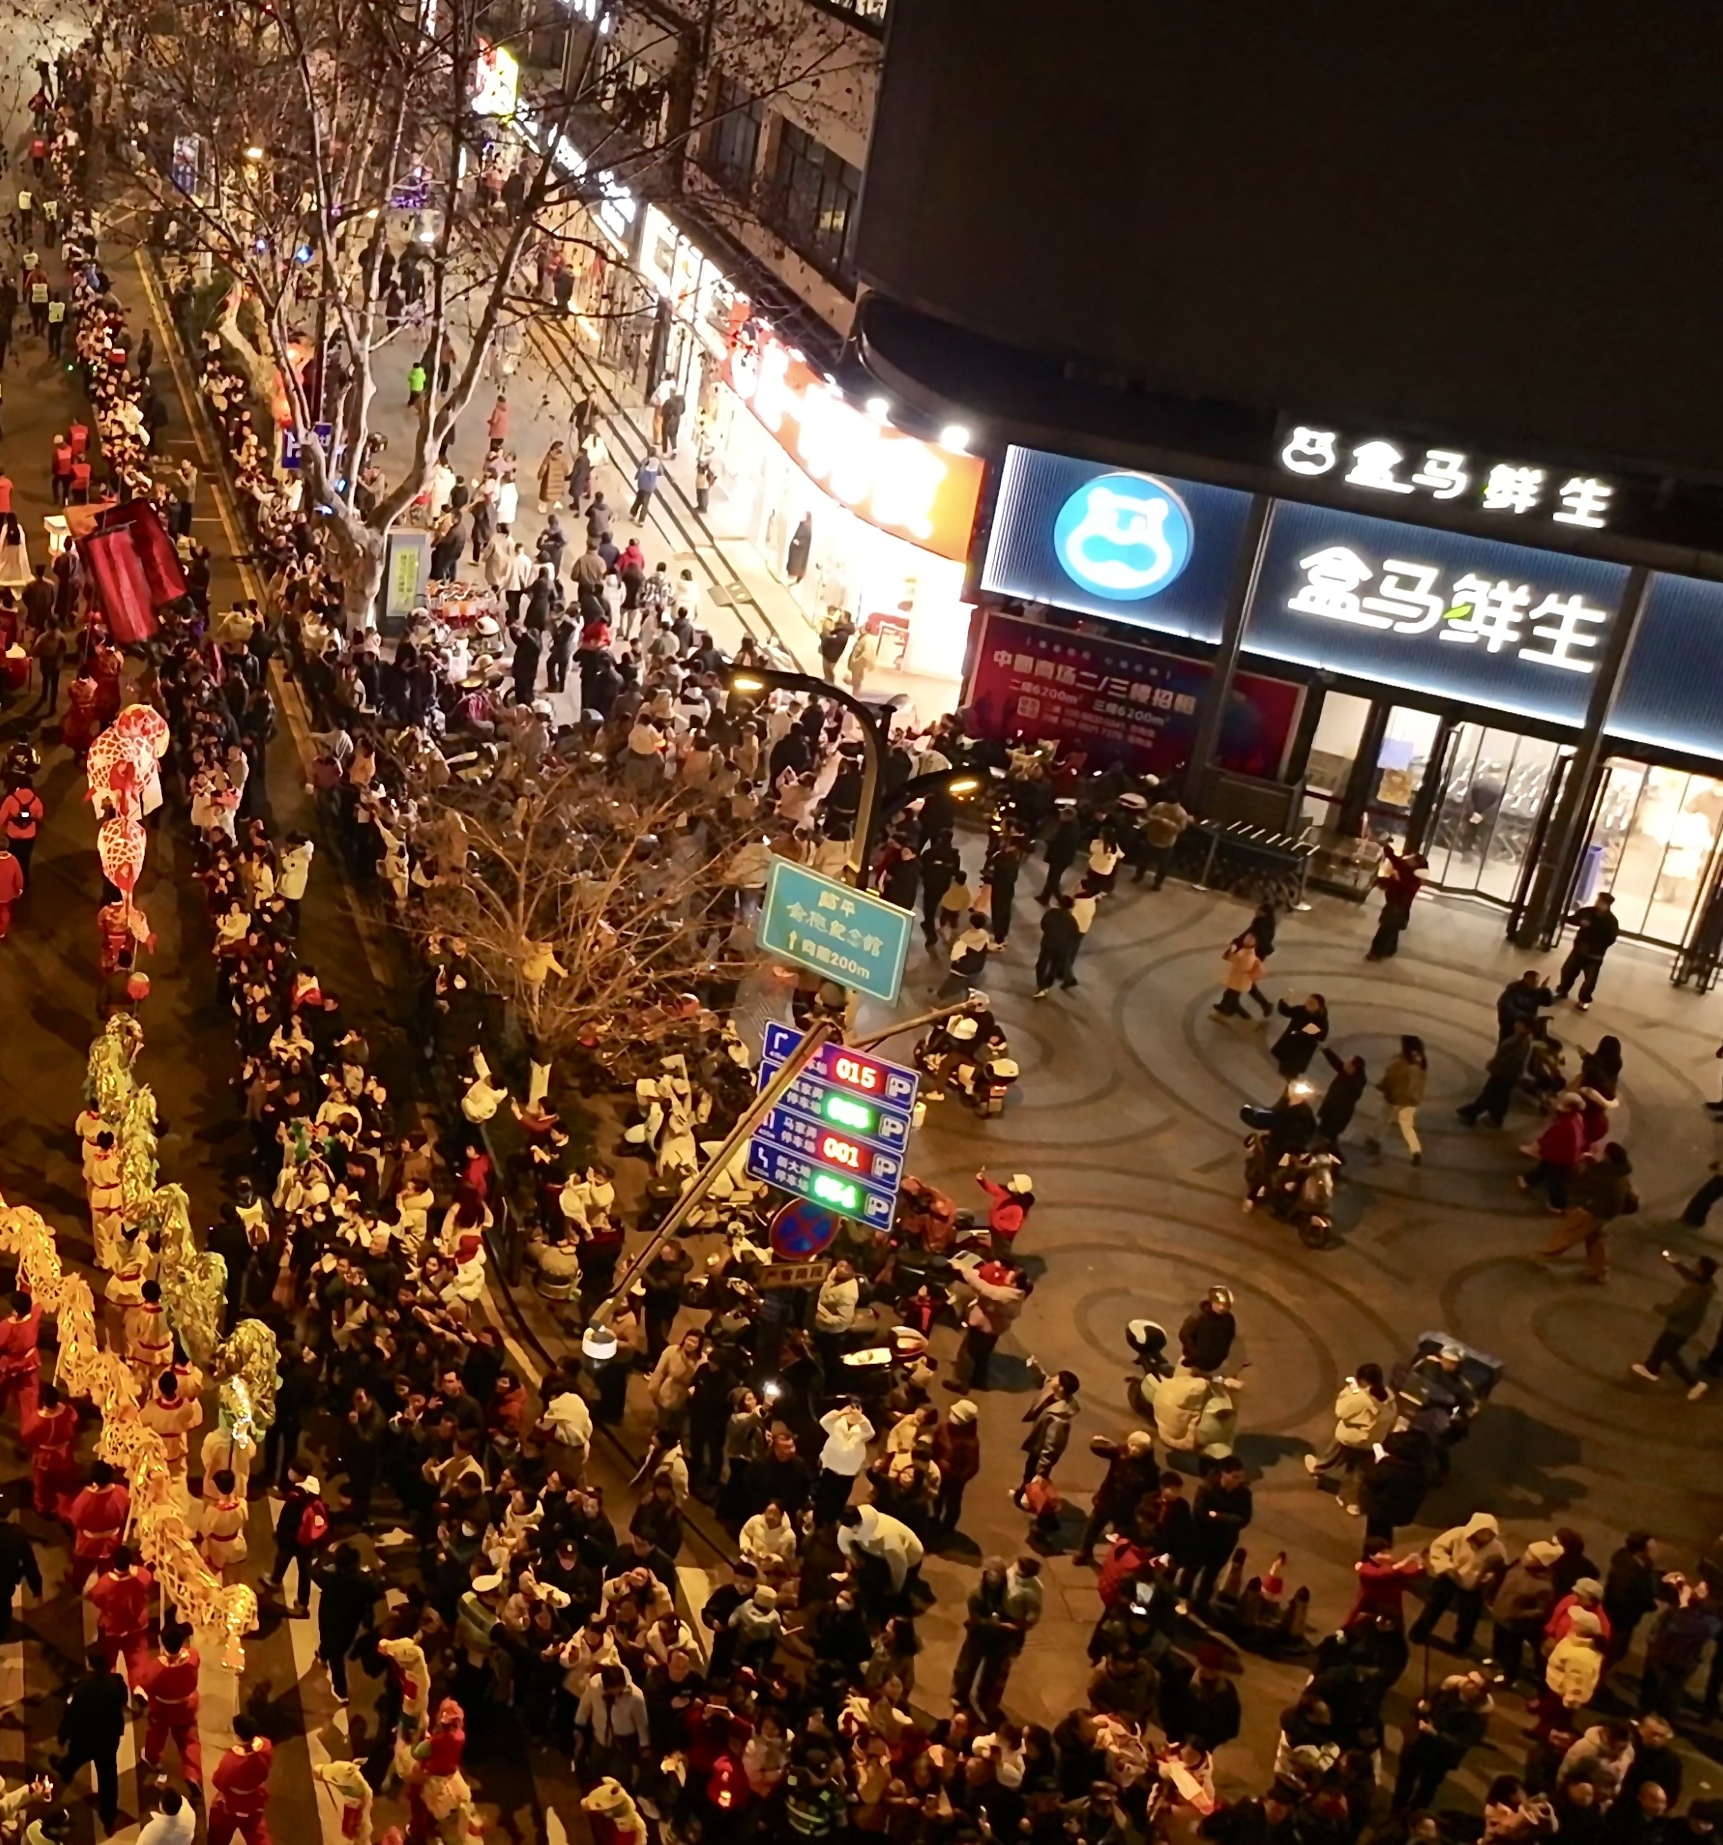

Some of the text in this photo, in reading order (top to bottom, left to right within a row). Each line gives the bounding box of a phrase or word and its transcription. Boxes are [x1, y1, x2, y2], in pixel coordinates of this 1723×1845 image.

[1343, 440, 1613, 529] 盒马鲜生
[1287, 546, 1607, 674] 盒马鲜生
[836, 1058, 876, 1089] 015
[823, 1137, 859, 1168] 001
